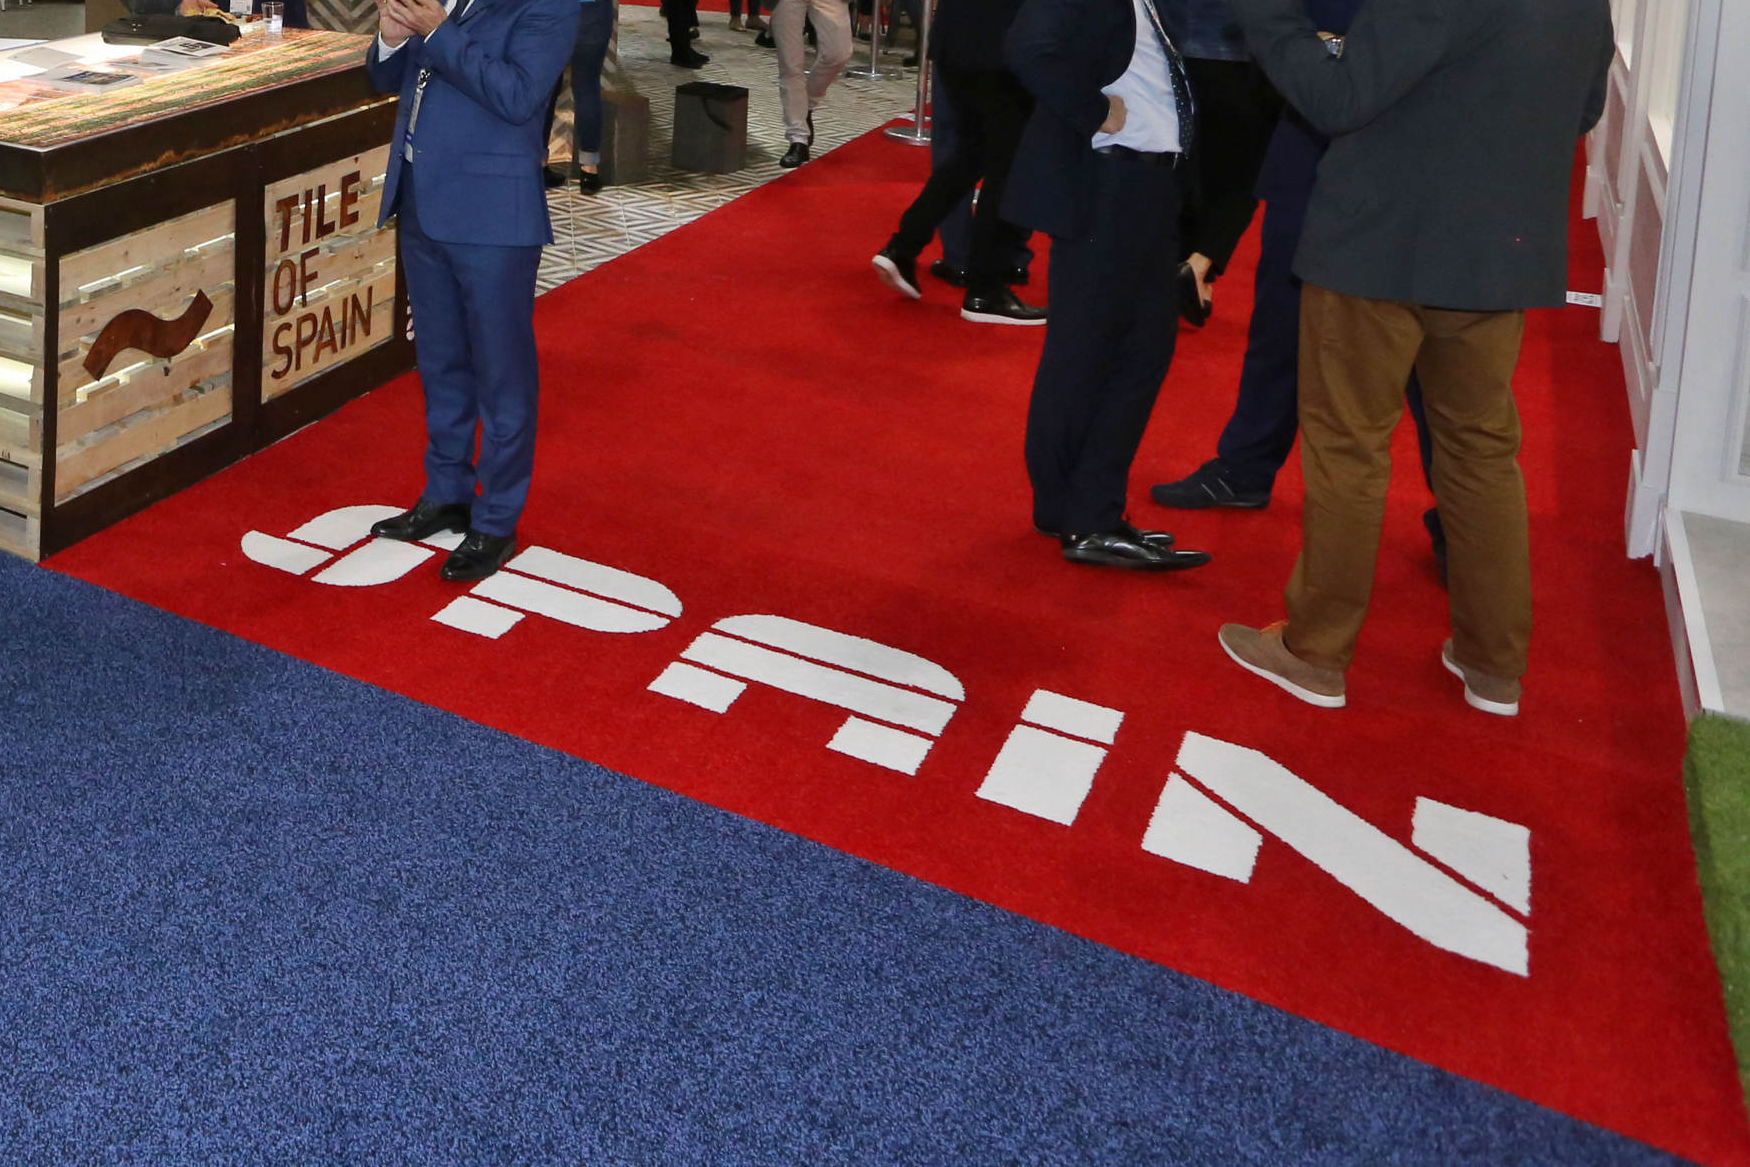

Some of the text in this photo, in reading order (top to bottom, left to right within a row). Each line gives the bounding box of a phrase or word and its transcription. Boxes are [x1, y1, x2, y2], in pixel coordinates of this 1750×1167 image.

[276, 170, 361, 253] TILE
[273, 248, 320, 316] OF
[270, 286, 373, 380] SPAIN
[241, 504, 1531, 977] SPAIN
